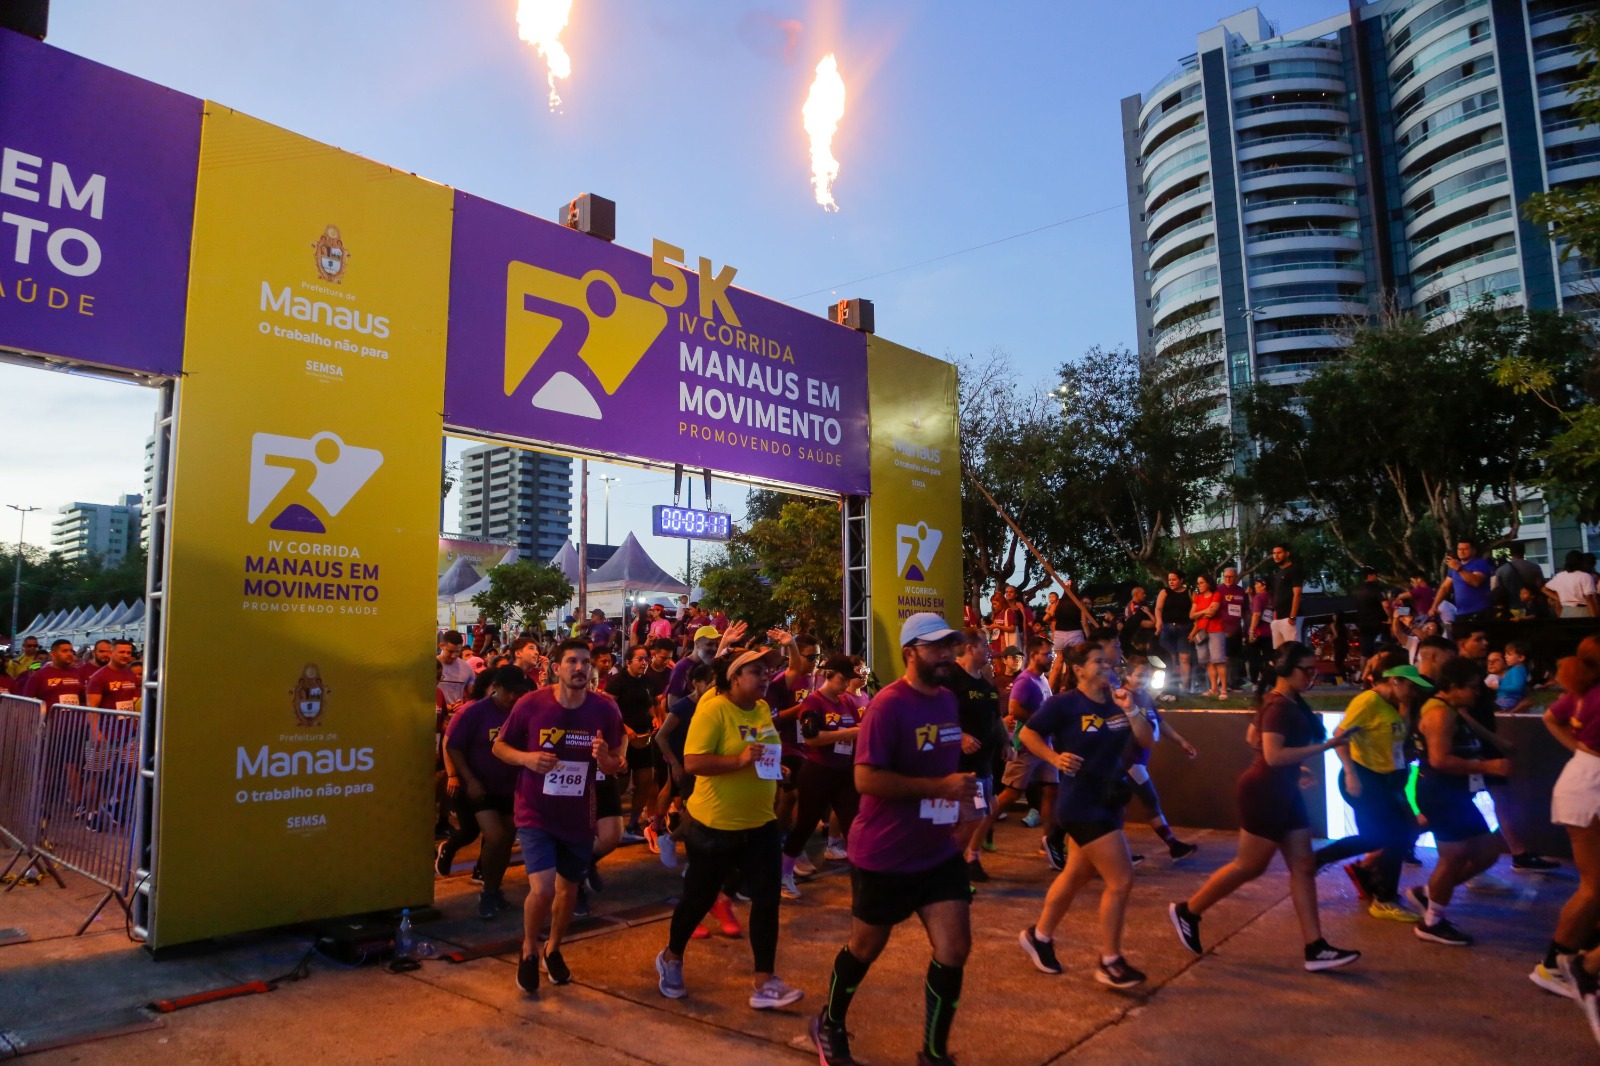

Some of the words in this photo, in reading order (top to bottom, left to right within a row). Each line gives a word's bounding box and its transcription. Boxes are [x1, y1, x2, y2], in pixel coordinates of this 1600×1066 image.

[0, 146, 106, 220] EM
[301, 281, 344, 298] Prefeitura
[346, 292, 356, 301] de
[649, 237, 742, 328] 5K
[260, 280, 390, 339] Manaus
[259, 321, 271, 334] O
[273, 325, 332, 347] trabalho
[334, 339, 358, 353] não
[361, 346, 389, 360] para
[679, 311, 698, 335] IV
[703, 320, 795, 365] CORRIDA
[305, 360, 344, 377] SEMSA
[679, 341, 799, 400] MANAUS
[807, 377, 840, 411] EM
[679, 381, 842, 445] MOVIMENTO
[679, 421, 791, 457] PROMOVENDO
[799, 447, 842, 467] SAÚDE
[269, 540, 284, 553] IV
[287, 541, 361, 559] CORRIDA
[245, 555, 343, 579] MANAUS
[350, 563, 379, 581] EM
[243, 578, 379, 602] MOVIMENTO
[897, 595, 932, 607] MANAUS
[933, 597, 944, 608] EM
[911, 586, 937, 595] CORRIDA
[242, 601, 334, 614] PROMOVENDO
[340, 605, 378, 615] SAÚDE
[280, 733, 324, 742] Prefeitura
[327, 733, 337, 741] de
[236, 745, 374, 779] Manaus
[549, 773, 583, 785] 2168
[236, 790, 249, 803] O
[251, 786, 313, 802] trabalho
[316, 784, 341, 796] não
[344, 783, 374, 797] para
[287, 814, 327, 828] SEMSA
